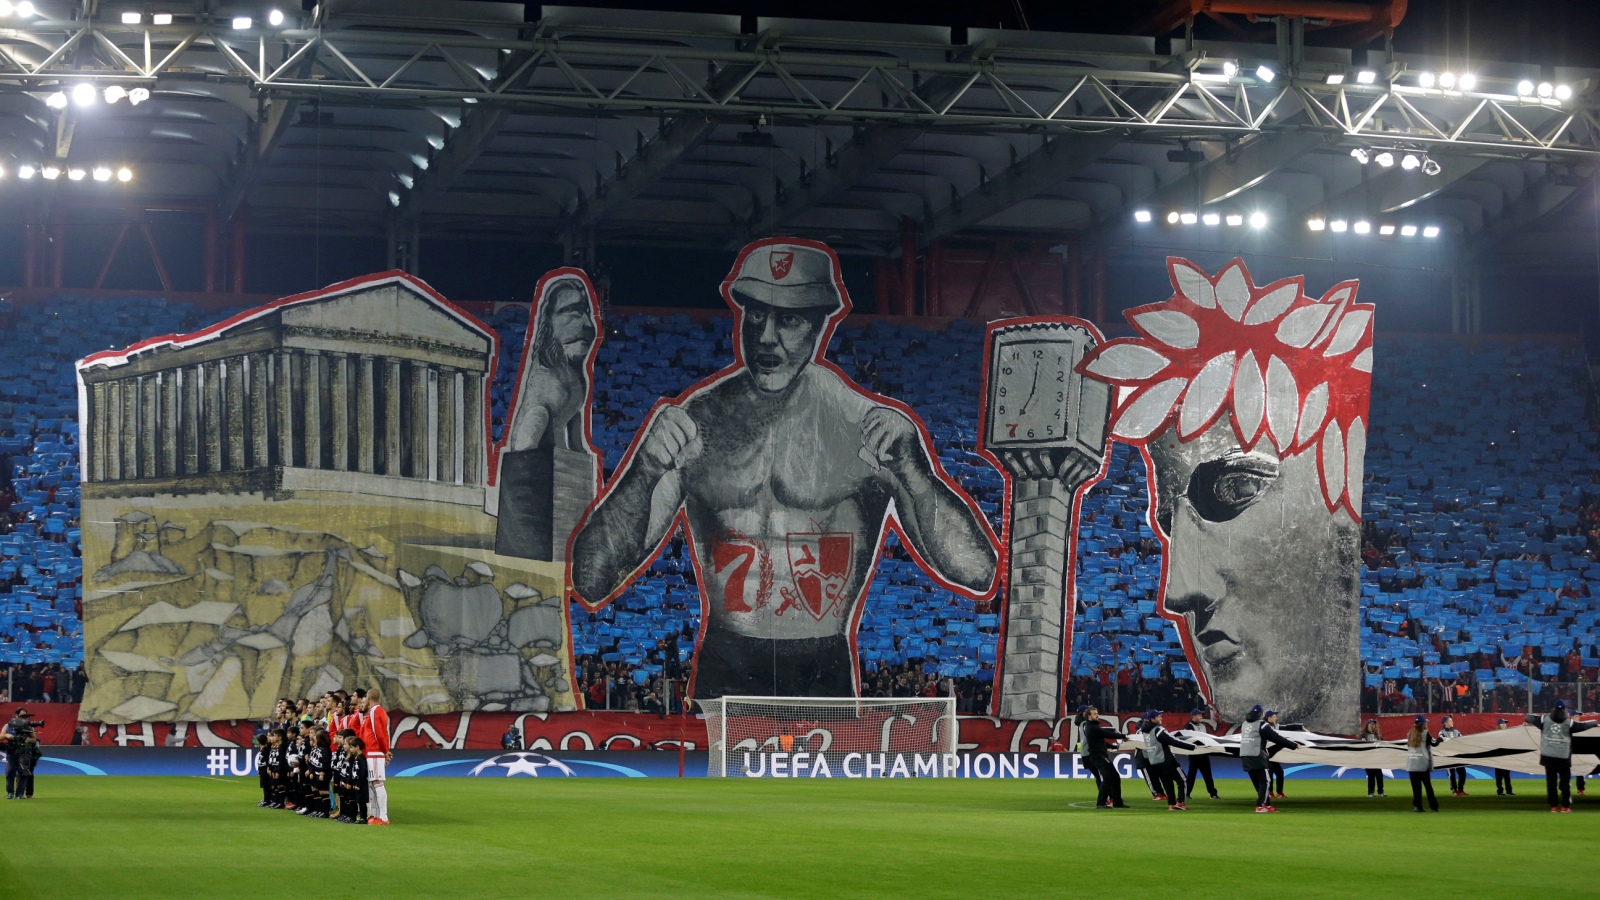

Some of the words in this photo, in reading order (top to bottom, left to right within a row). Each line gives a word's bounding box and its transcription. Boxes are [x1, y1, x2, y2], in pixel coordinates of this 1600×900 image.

[1012, 352, 1019, 360] 11
[1033, 350, 1043, 359] 12
[1002, 367, 1012, 375] 10
[1056, 371, 1064, 382] 2
[999, 387, 1007, 397] 9
[1056, 392, 1064, 403] 3
[998, 405, 1006, 414] 8
[1054, 408, 1061, 419] 4
[1005, 423, 1018, 438] 7
[1027, 429, 1035, 438] 6
[1046, 425, 1053, 436] 5
[712, 540, 755, 612] 7
[206, 748, 258, 777] #U
[744, 752, 832, 778] UEFA
[842, 752, 1040, 778] CHAMPIONS
